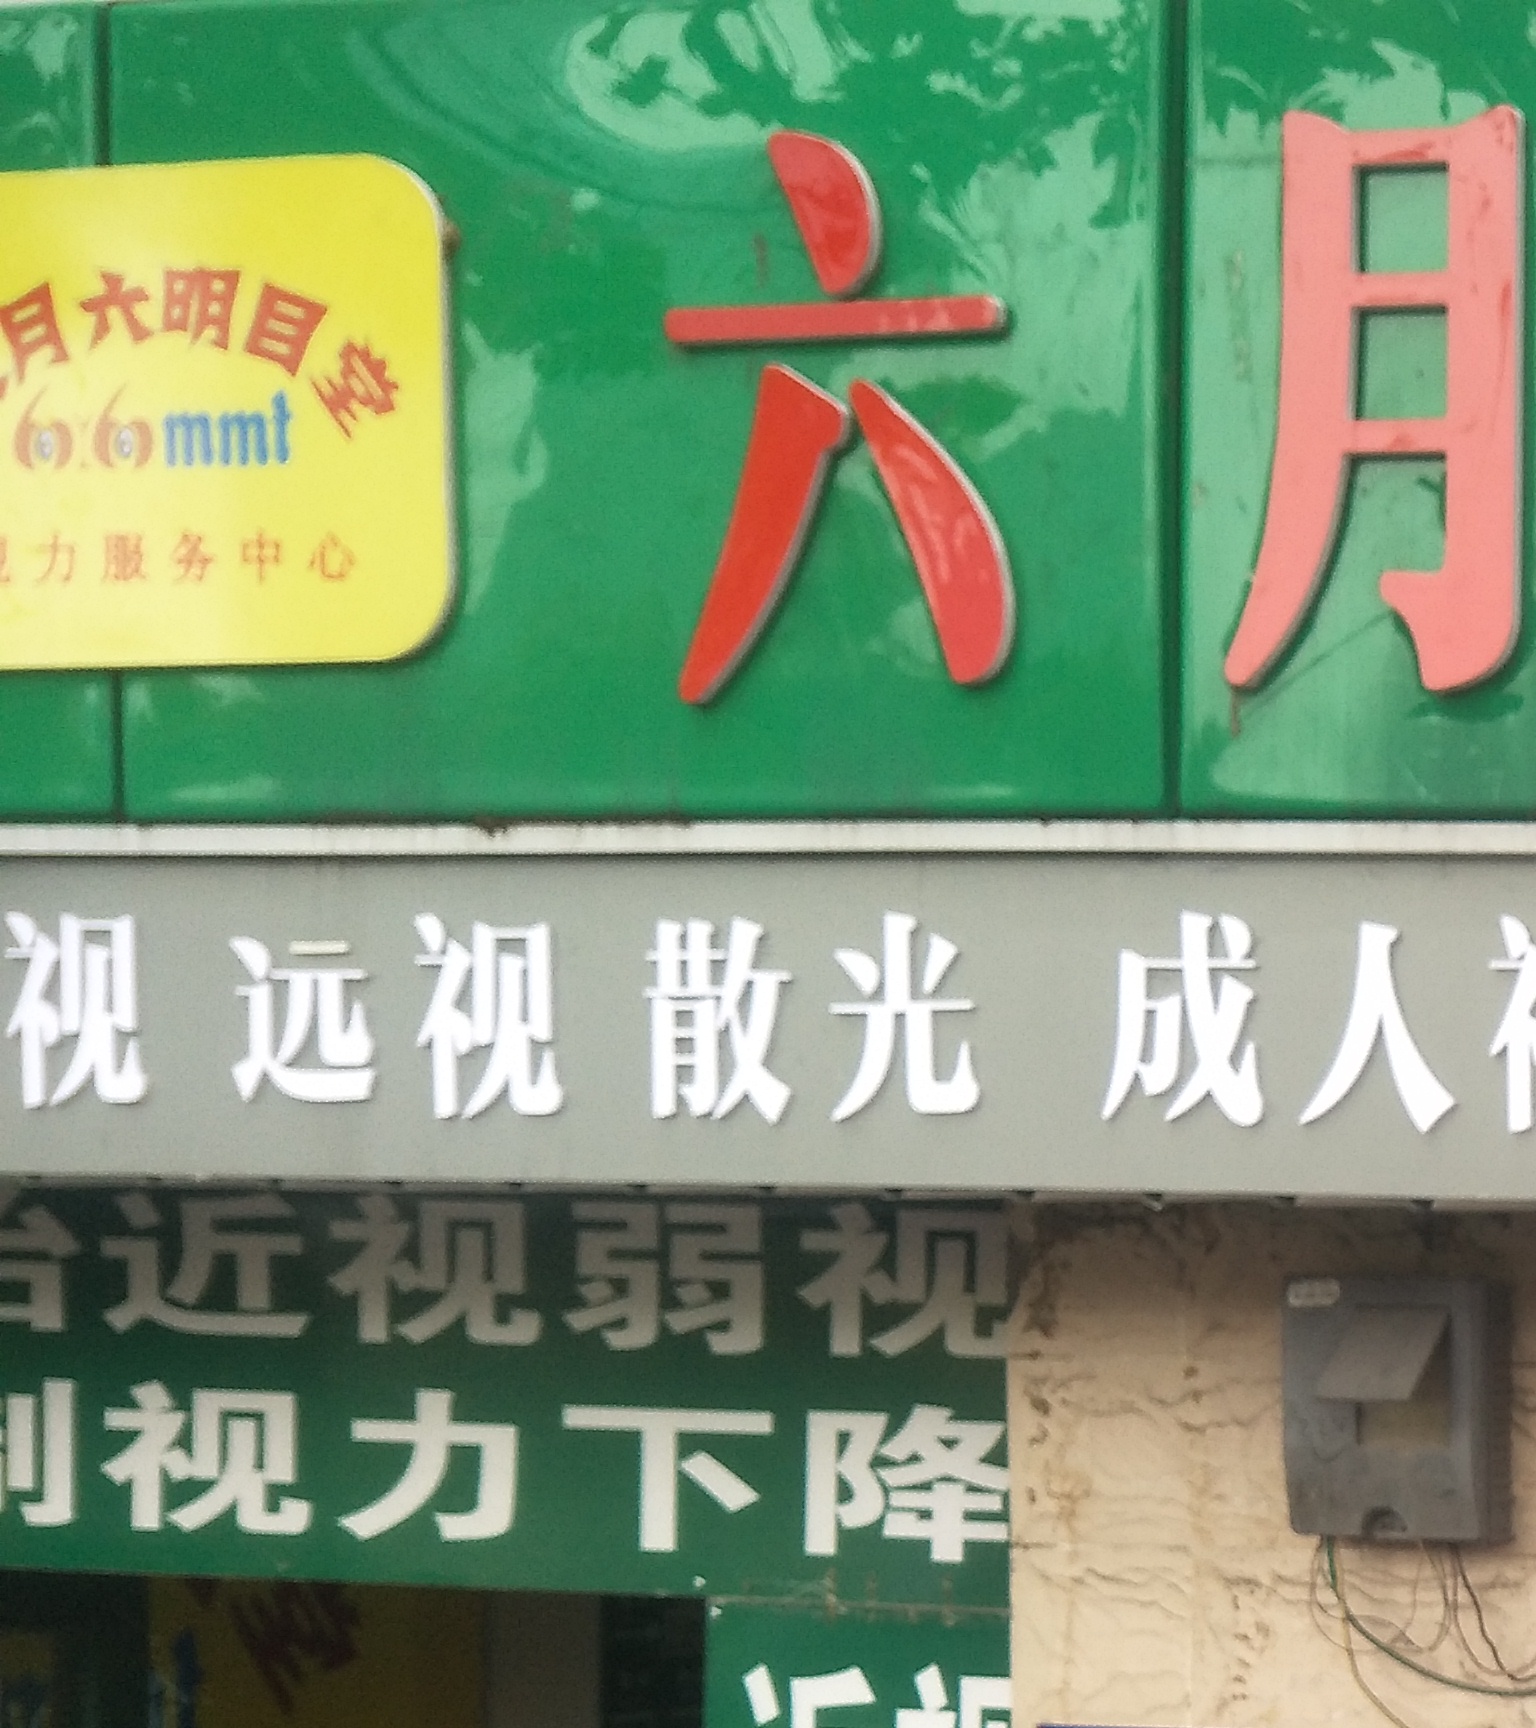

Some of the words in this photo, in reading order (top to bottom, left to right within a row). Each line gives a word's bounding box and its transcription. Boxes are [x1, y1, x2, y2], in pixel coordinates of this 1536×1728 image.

[0, 266, 399, 440] 月六明目堂
[4, 911, 150, 1110] 视
[229, 911, 566, 1121] 远视
[643, 909, 982, 1124] 散光
